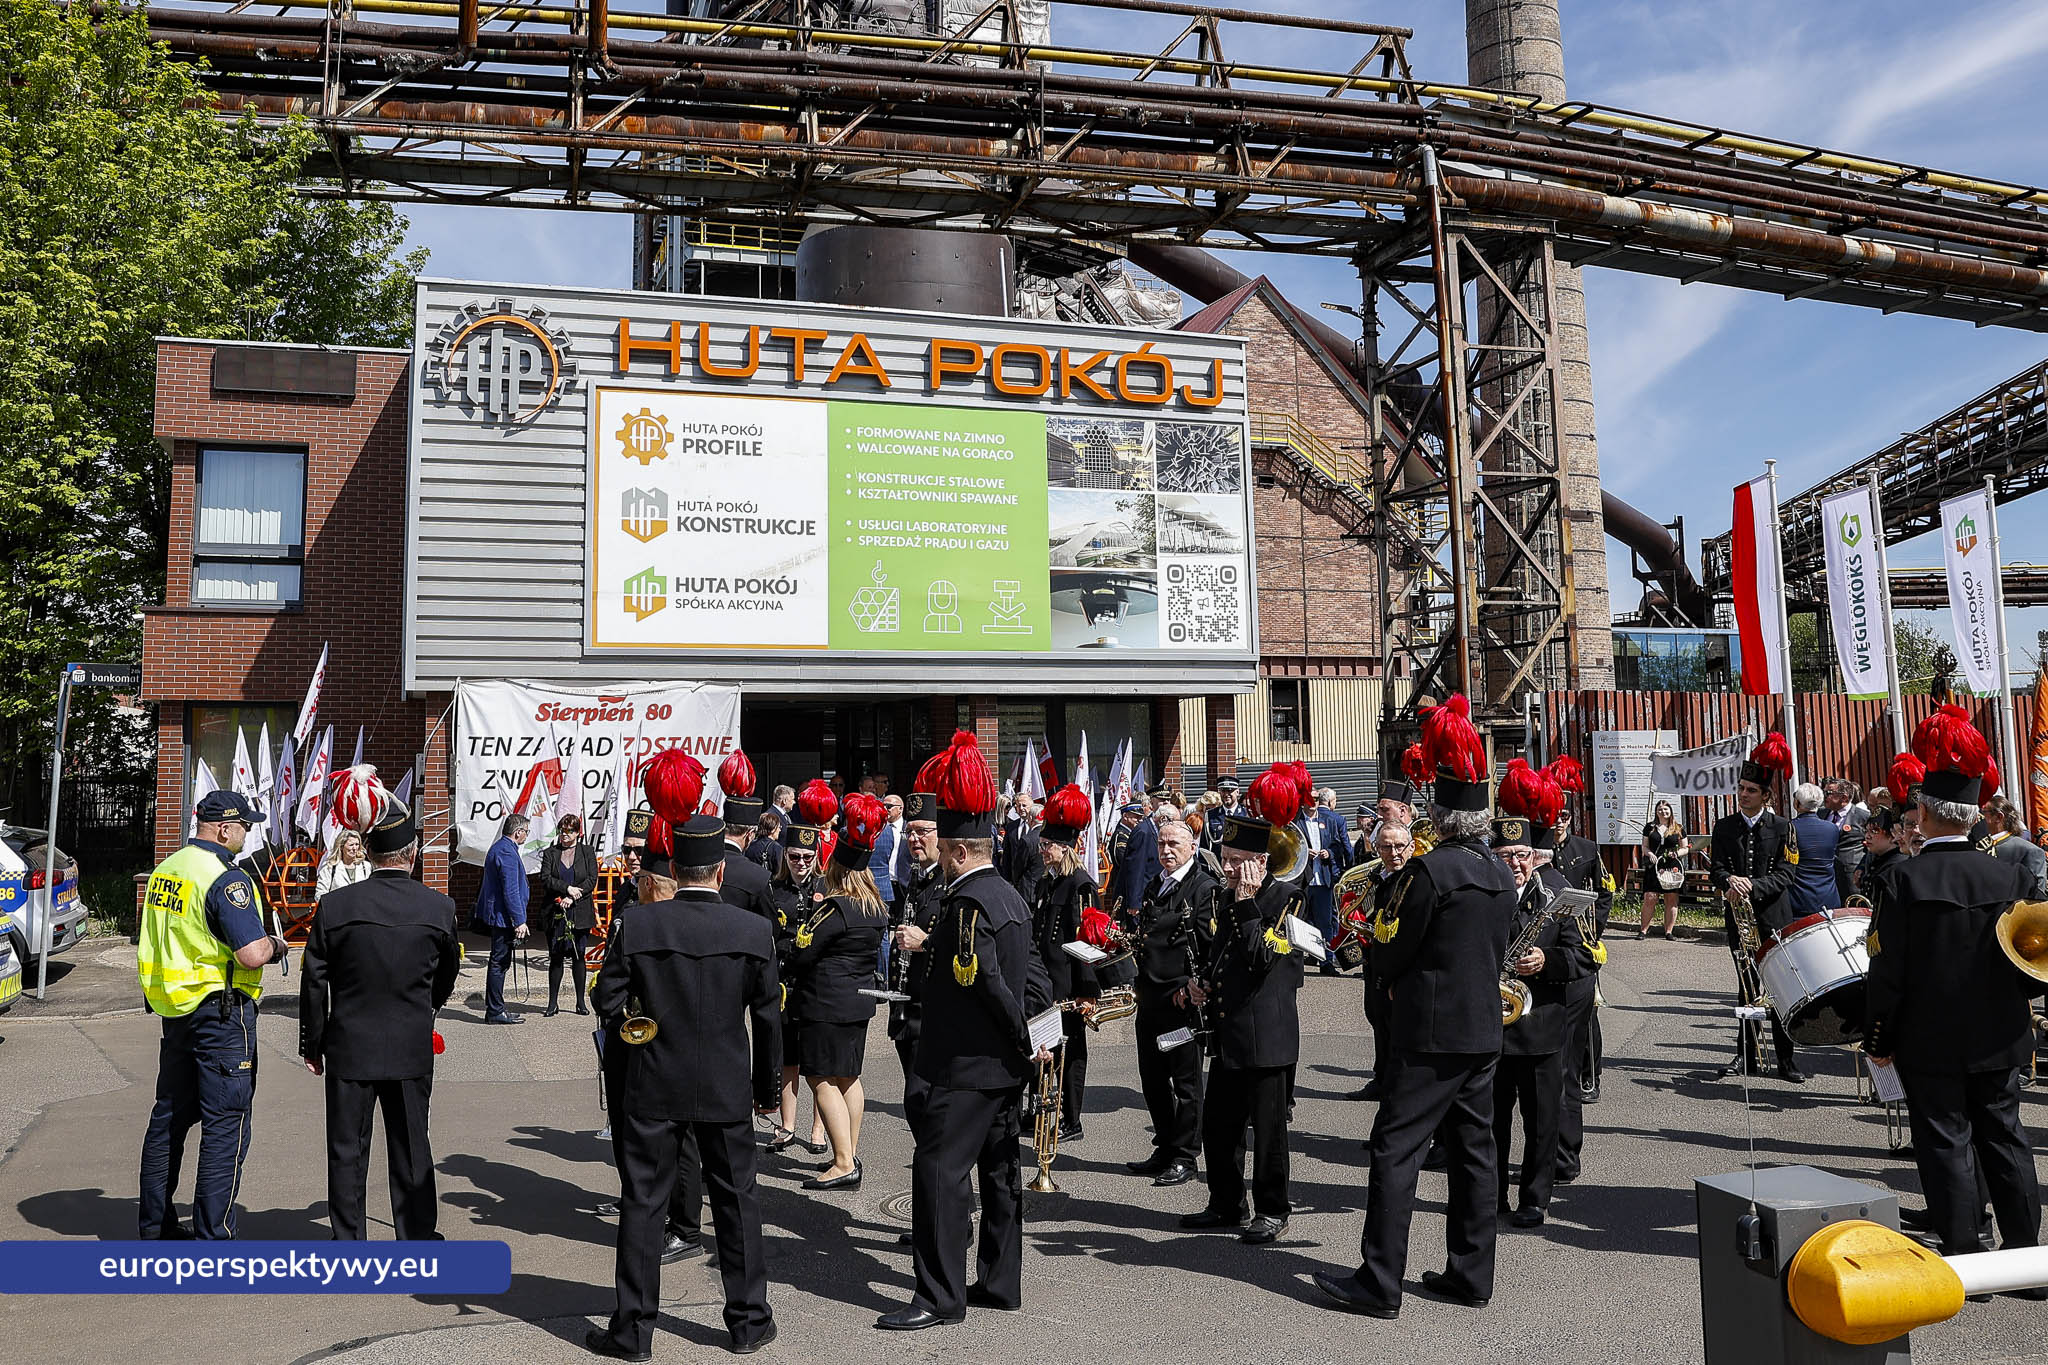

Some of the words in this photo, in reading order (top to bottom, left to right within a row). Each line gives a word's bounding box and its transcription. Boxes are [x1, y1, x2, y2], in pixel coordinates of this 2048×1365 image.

[619, 318, 892, 387] HUTA
[930, 338, 1224, 407] POKÓJ
[682, 423, 718, 435] HUTA
[721, 423, 763, 436] POKÓJ
[857, 426, 941, 441] FORMOWANE
[943, 431, 961, 443] NA
[963, 432, 1005, 445] ZIMNO
[682, 438, 763, 457] PROFILE
[857, 442, 940, 457] WALCOWANE
[942, 447, 960, 458] NA
[963, 448, 1014, 461] GORĄCO
[858, 472, 946, 487] KONSTRUKCJE
[948, 476, 1005, 489] STALOWE
[858, 488, 958, 502] KSZTAŁTOWNIKI
[960, 492, 1018, 505] SPAWANE
[677, 500, 713, 512] HUTA
[716, 501, 758, 514] POKÓJ
[676, 515, 816, 536] KONSTRUKCJE
[858, 519, 903, 531] USŁUGI
[906, 521, 1008, 535] LABORATORYJNE
[858, 535, 922, 548] SPRZEDAŻ
[924, 538, 967, 551] PRĄDU
[976, 539, 1009, 550] GAZU
[675, 577, 730, 594] HUTA
[734, 575, 798, 595] POKÓJ
[675, 596, 725, 610] SPÓŁKA
[727, 599, 784, 611] AKCYJNA
[1962, 571, 1979, 624] POKÓJ
[1977, 581, 1986, 627] AKCYJNA
[1849, 553, 1872, 673] WĘGLOKOKS
[1972, 627, 1985, 671] HUTA
[1982, 629, 1991, 670] SPÓŁKA
[92, 673, 139, 683] bankomat
[535, 702, 634, 726] Sierpień
[645, 703, 673, 720] 80
[468, 736, 513, 756] TEN
[623, 736, 733, 757] ZOSTANIE
